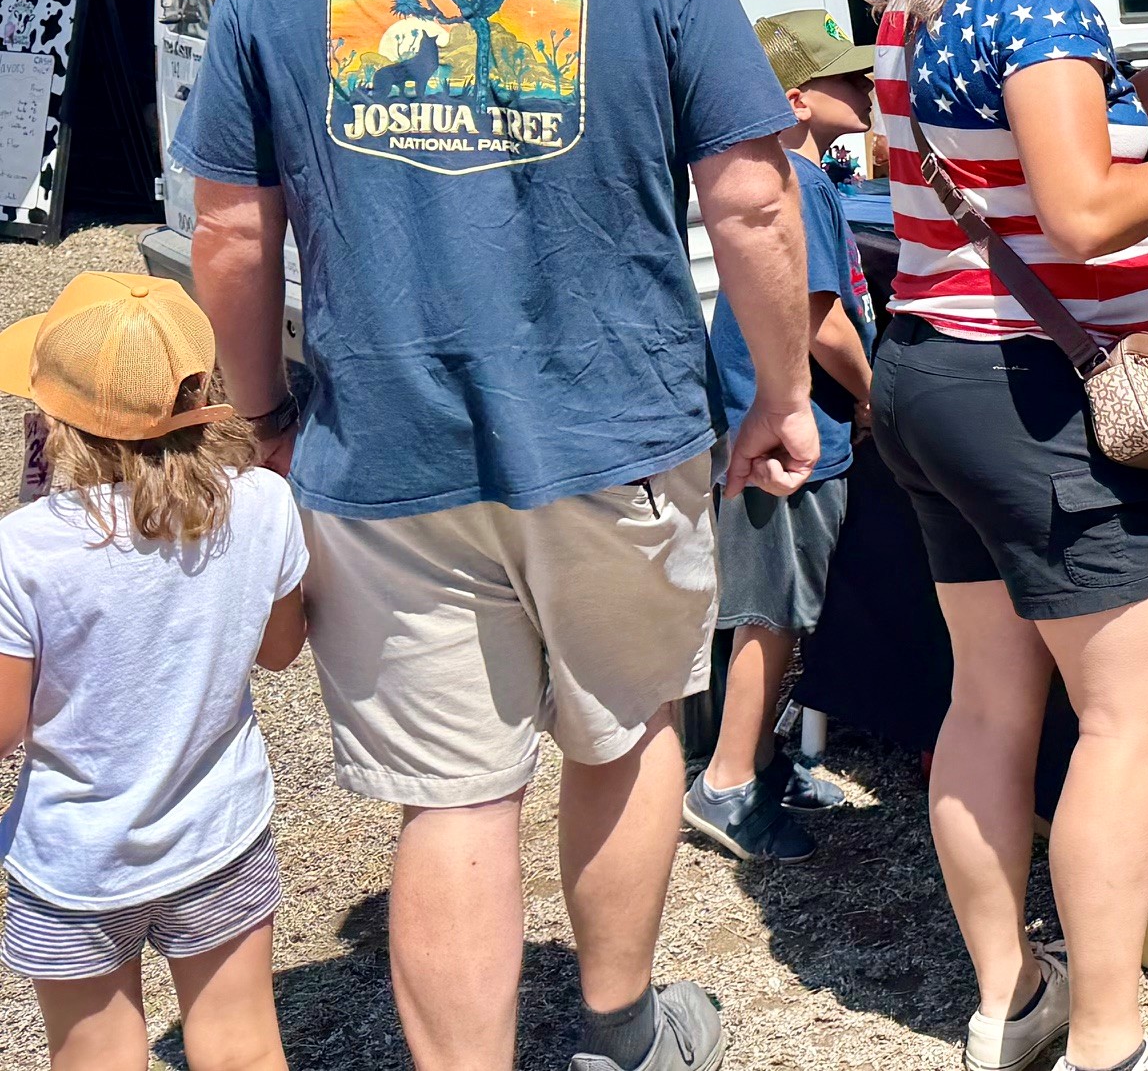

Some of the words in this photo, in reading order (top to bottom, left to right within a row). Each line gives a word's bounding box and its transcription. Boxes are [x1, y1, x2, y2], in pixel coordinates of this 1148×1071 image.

[344, 103, 479, 141] JOSHUA
[487, 106, 563, 148] TREE
[389, 136, 475, 152] NATIONAL
[477, 139, 520, 155] PARK
